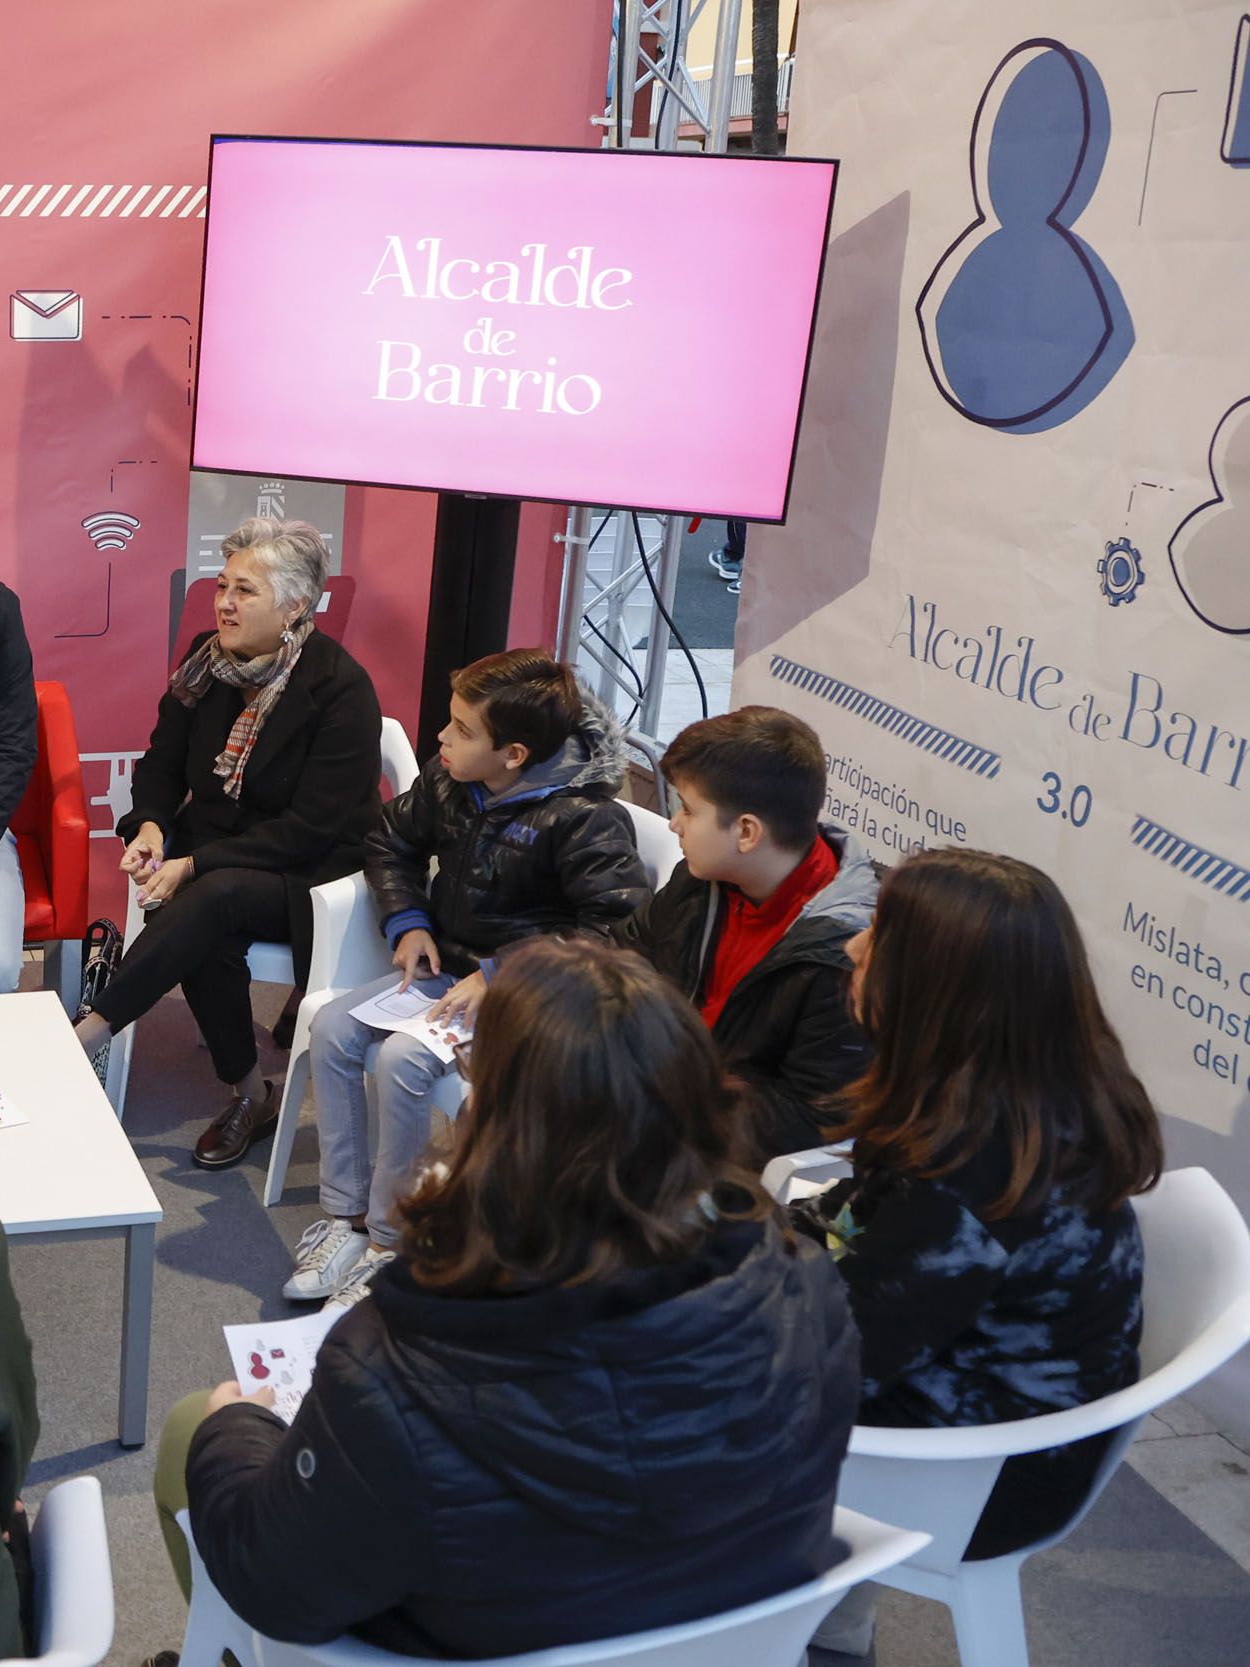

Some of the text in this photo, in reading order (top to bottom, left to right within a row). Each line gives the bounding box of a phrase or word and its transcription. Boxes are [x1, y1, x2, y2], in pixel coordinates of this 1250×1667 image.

[361, 235, 633, 310] Alcalde
[463, 317, 517, 356] de
[371, 340, 602, 415] Barrio
[887, 594, 1064, 710] Alcalde
[1069, 694, 1111, 741] de
[926, 808, 966, 842] que
[1037, 772, 1092, 827] 3.0
[862, 808, 877, 839] la
[882, 824, 934, 855] ciud
[1123, 902, 1229, 990] Mislata,
[1131, 965, 1163, 998] en
[1193, 1039, 1239, 1085] del
